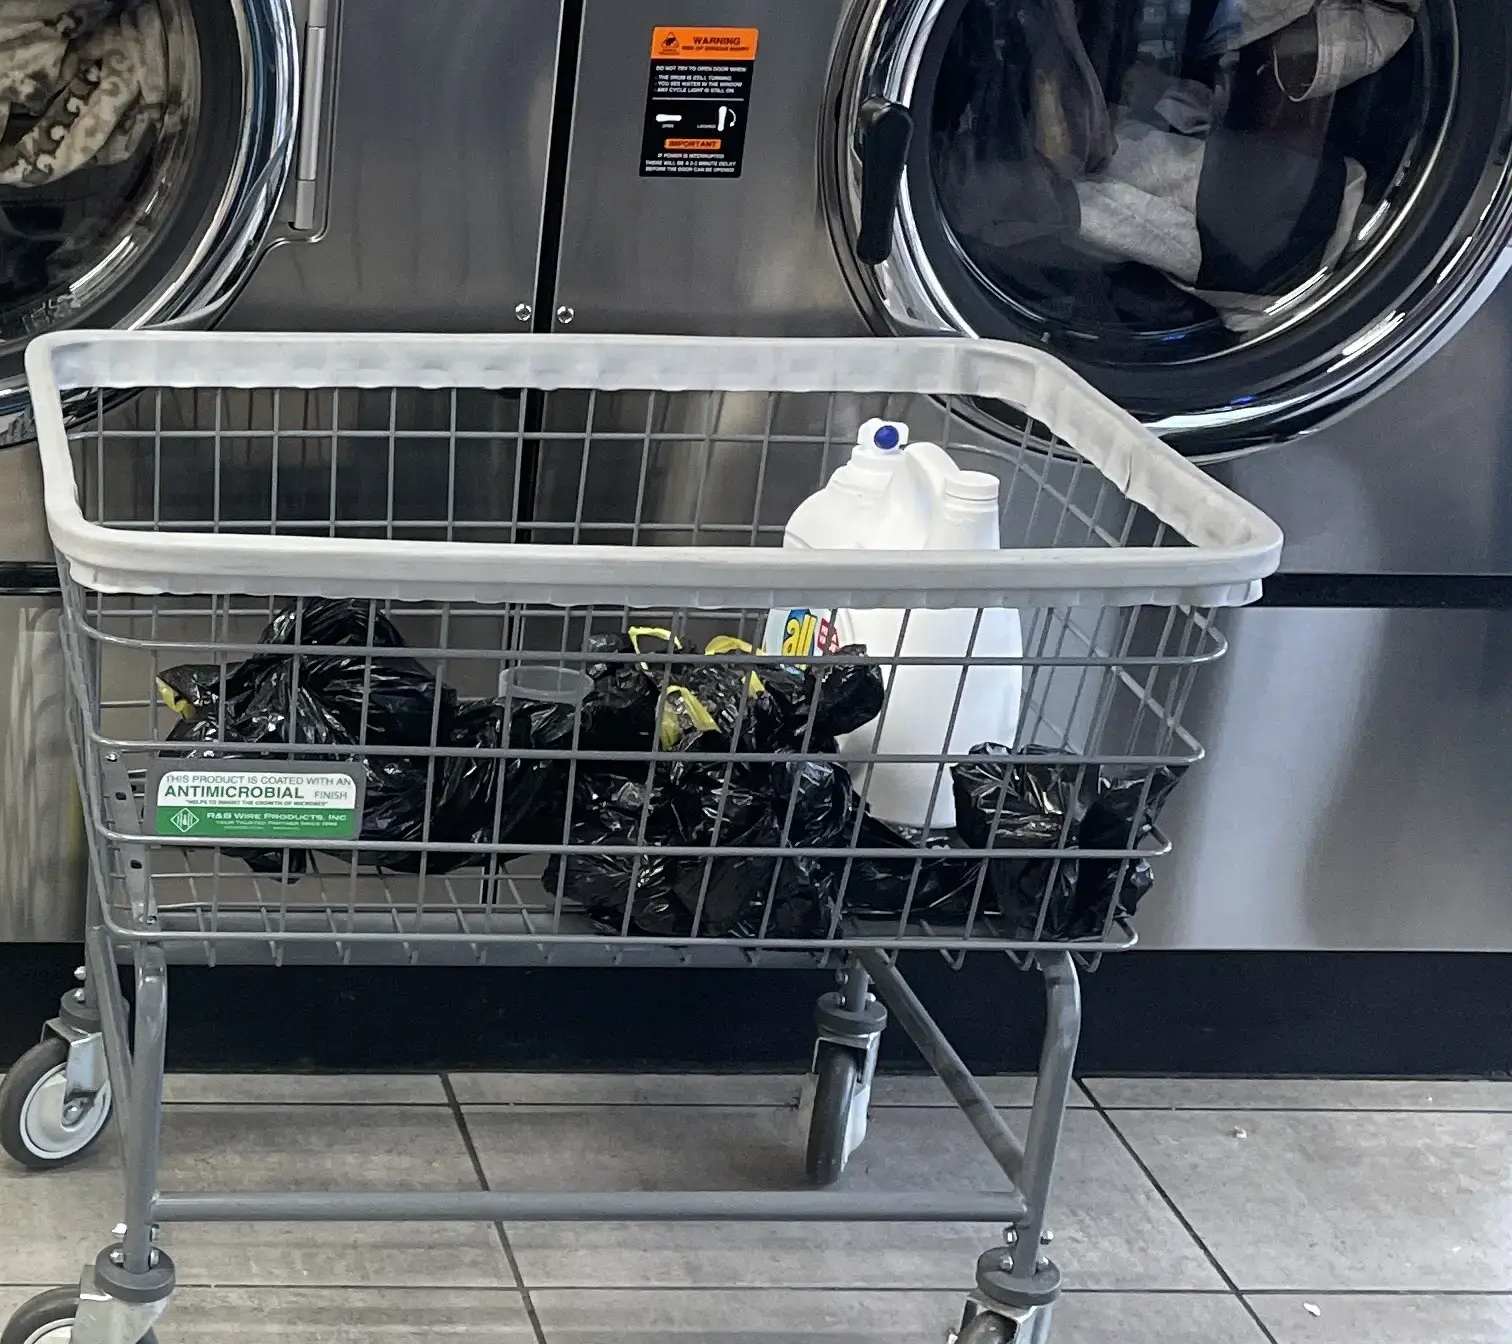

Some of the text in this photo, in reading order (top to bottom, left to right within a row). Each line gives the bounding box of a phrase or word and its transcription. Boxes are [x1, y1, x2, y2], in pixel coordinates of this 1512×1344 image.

[693, 36, 741, 45] WARNING
[782, 613, 817, 657] all
[166, 774, 189, 783] THIS
[192, 775, 244, 784] PRODUCT
[247, 776, 257, 784] IS
[261, 776, 304, 785] COATED
[306, 777, 334, 785] WITH
[165, 785, 347, 800] ANTIMICROBIAL FINISH
